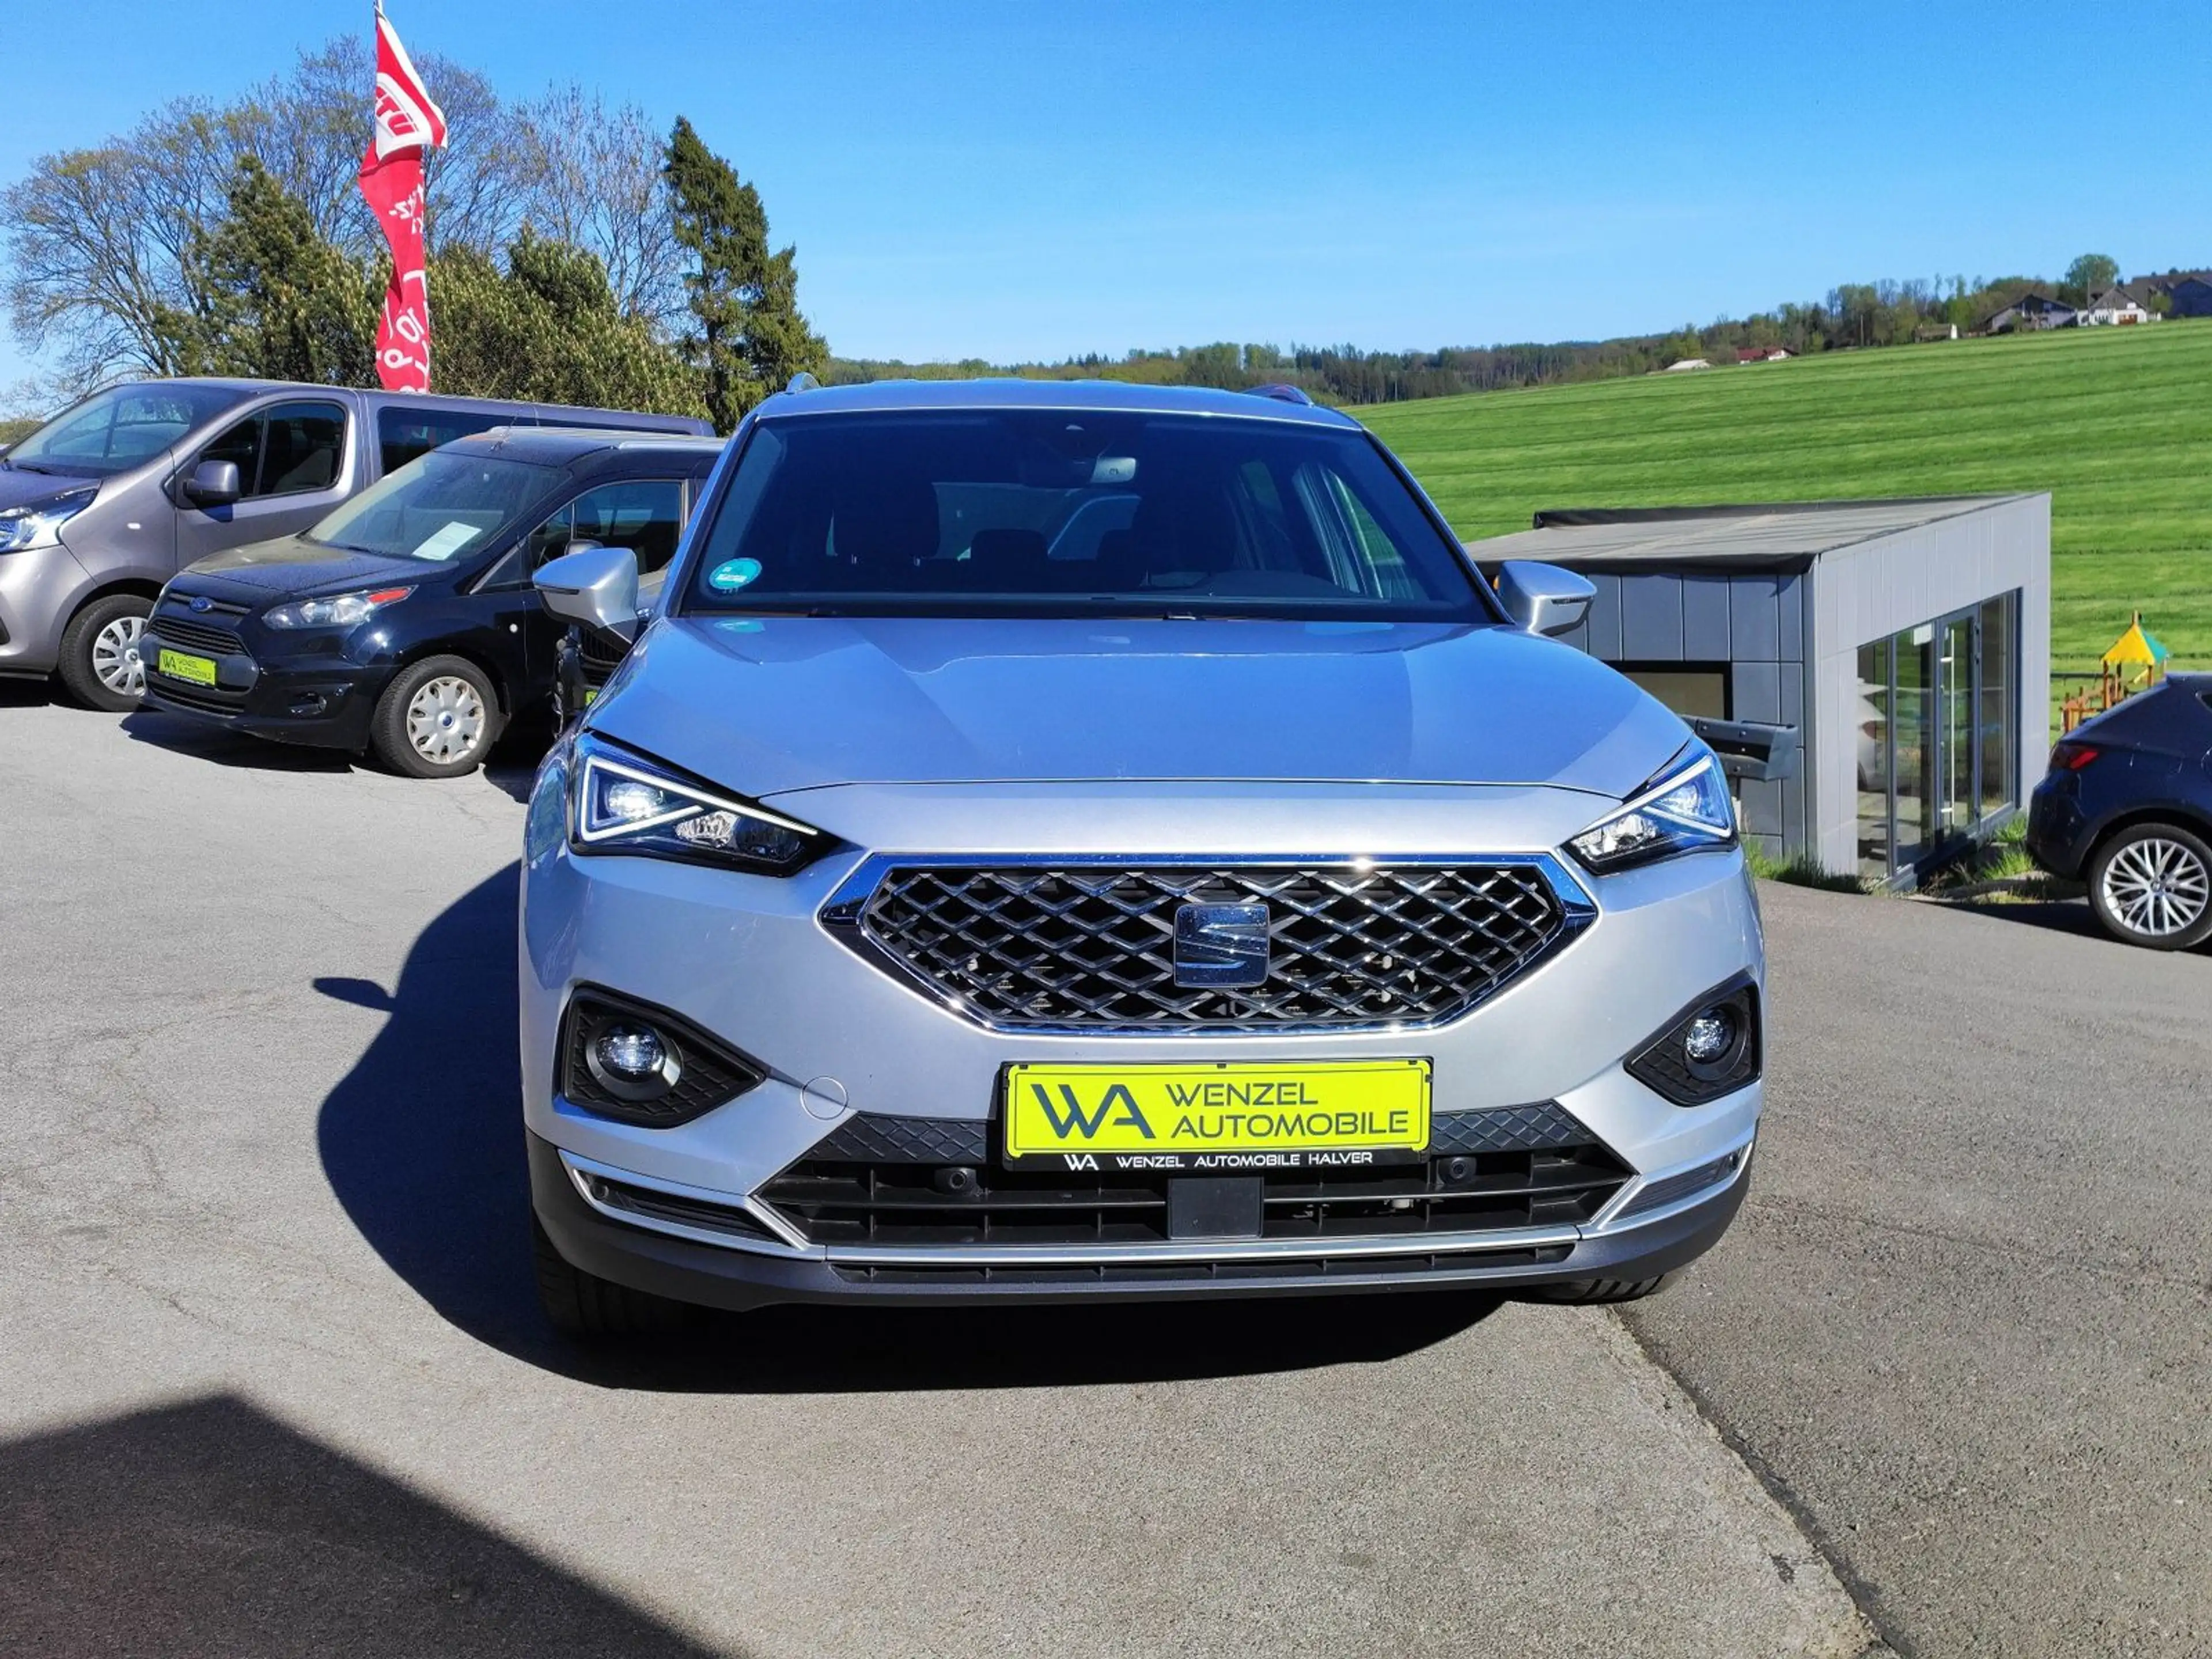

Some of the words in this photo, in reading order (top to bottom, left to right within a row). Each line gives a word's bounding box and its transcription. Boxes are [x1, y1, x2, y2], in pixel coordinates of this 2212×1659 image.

[1165, 1082, 1319, 1107] WENZEL
[1030, 1084, 1156, 1139] WA
[1171, 1111, 1409, 1139] AUTOMOBILE
[1063, 1154, 1100, 1171] WA
[1116, 1156, 1185, 1168] WENZEL
[1194, 1154, 1301, 1167] AUTOMOBILE
[1308, 1152, 1373, 1165] HALVER
